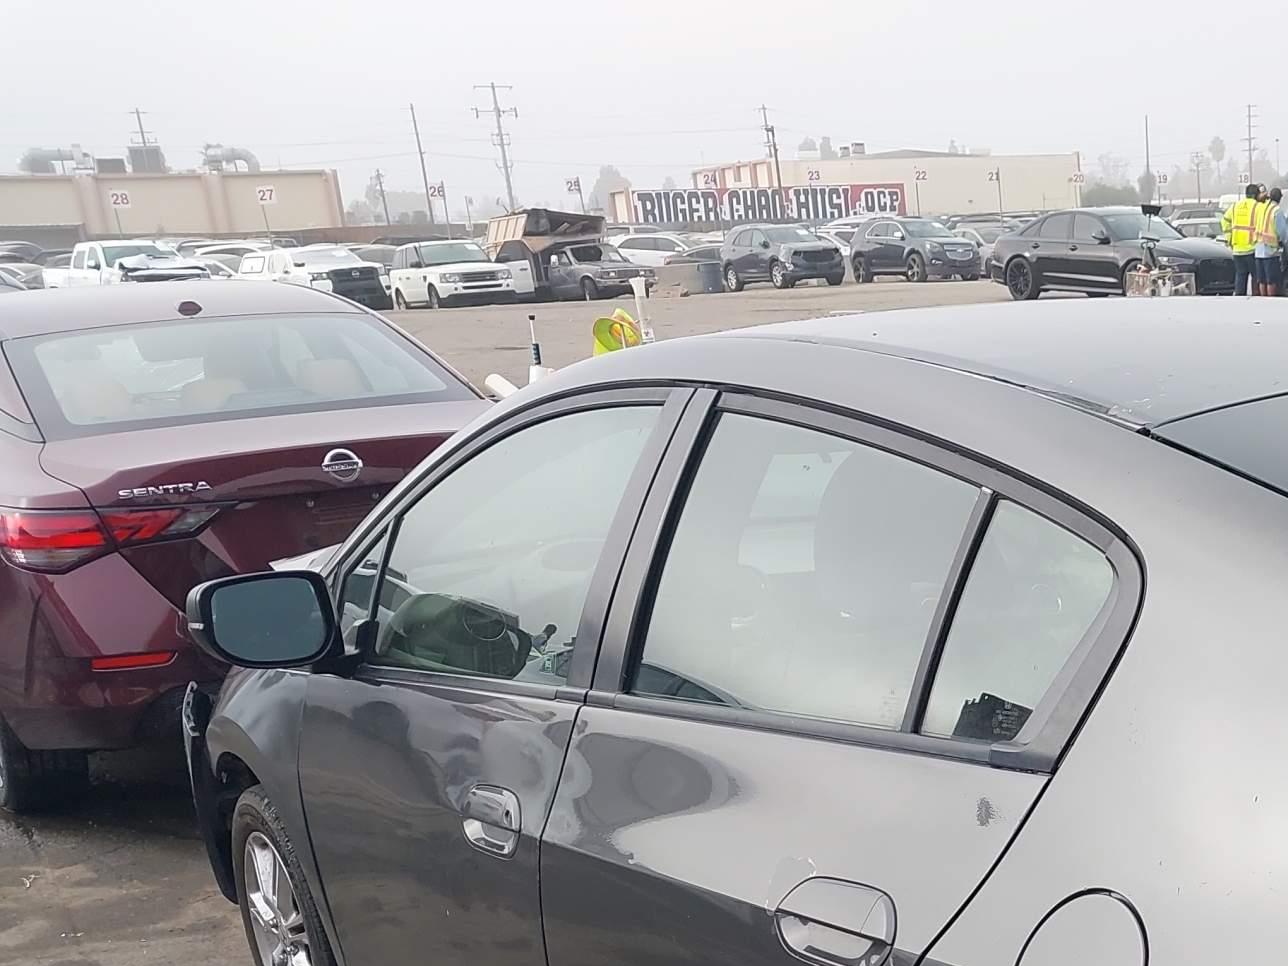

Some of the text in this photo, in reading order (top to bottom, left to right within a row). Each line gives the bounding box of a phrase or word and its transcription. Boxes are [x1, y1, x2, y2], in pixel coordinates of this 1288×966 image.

[702, 174, 715, 185] 24
[807, 170, 820, 180] 23
[914, 170, 926, 180] 22
[987, 171, 999, 182] 21
[1073, 173, 1084, 183] 20
[1157, 173, 1168, 184] 19
[1239, 174, 1249, 183] 18
[428, 185, 444, 198] 26
[566, 180, 581, 192] 25
[111, 192, 130, 206] 28
[257, 188, 273, 202] 27
[118, 481, 213, 500] SENTRA
